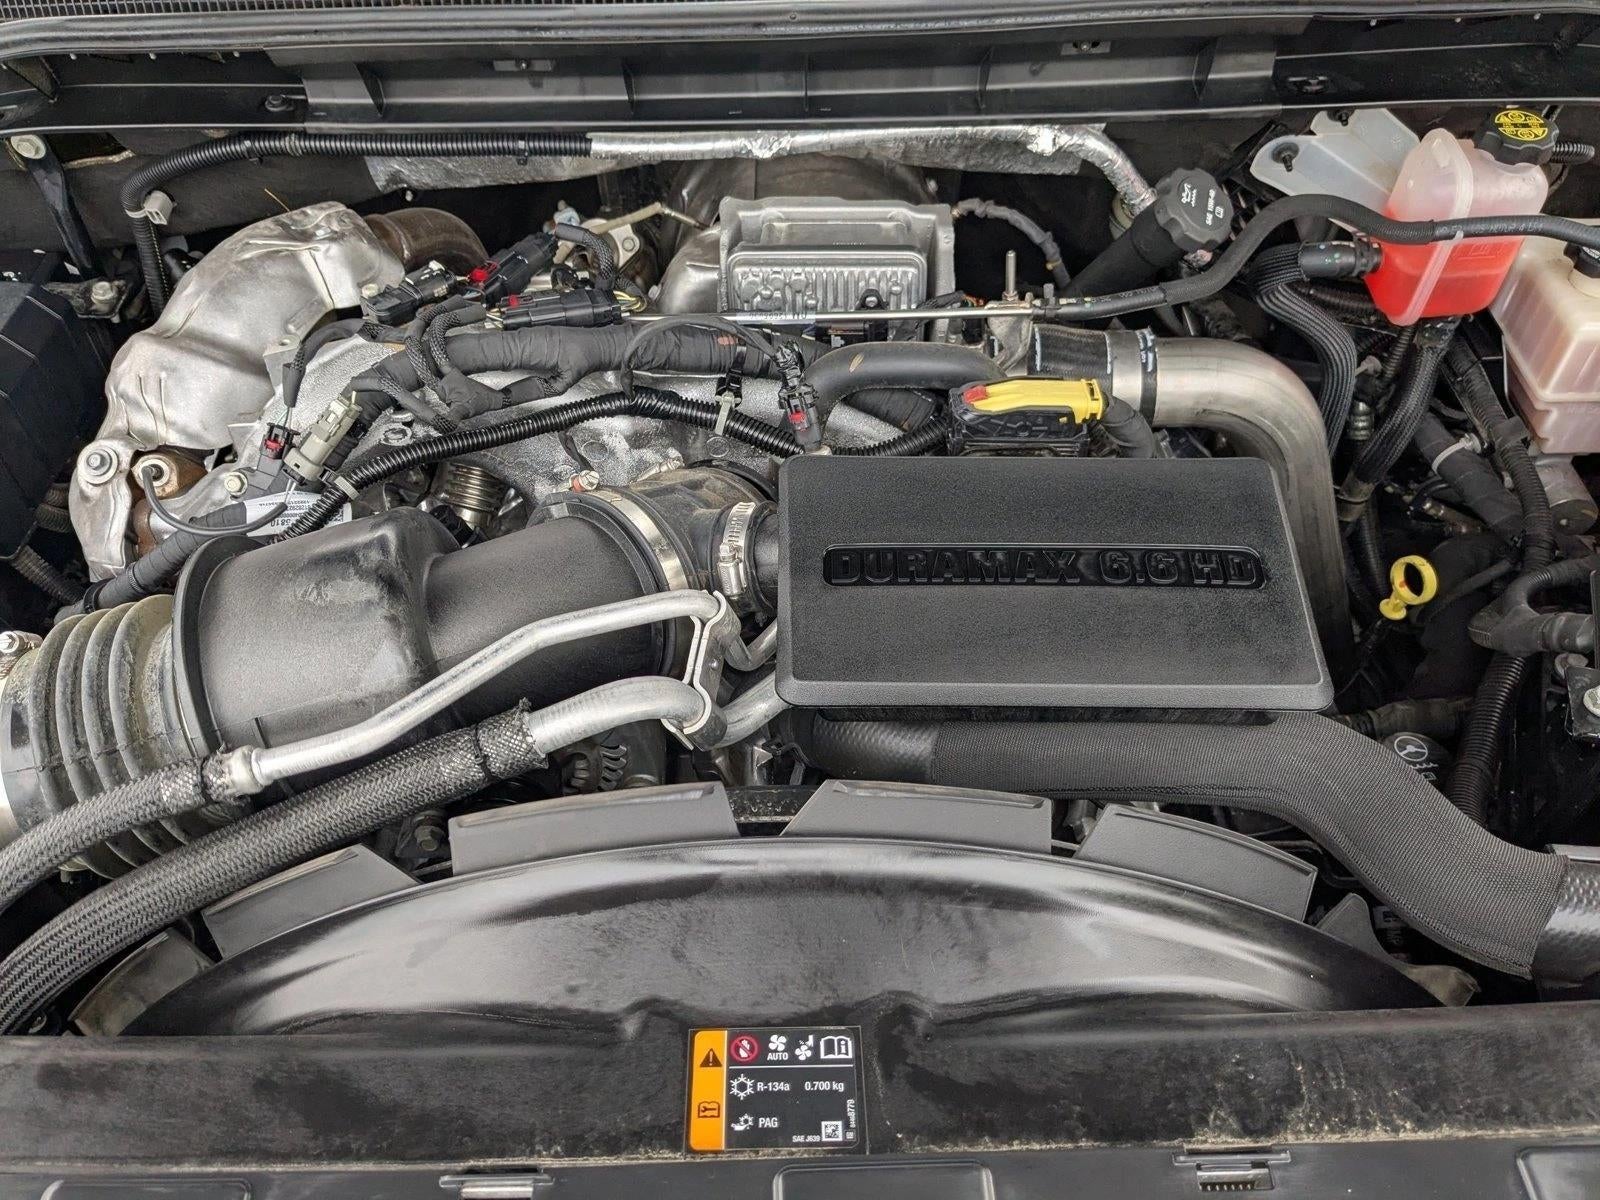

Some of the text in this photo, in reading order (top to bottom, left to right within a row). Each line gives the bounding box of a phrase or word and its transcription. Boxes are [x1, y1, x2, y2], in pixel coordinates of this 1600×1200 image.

[830, 548, 1257, 587] DURAMAX 6.6 HD
[766, 1052, 789, 1061] AUTO
[756, 1081, 845, 1093] R-134a 0.700 kg
[758, 1117, 779, 1128] PAG
[792, 1134, 821, 1142] SAE J639
